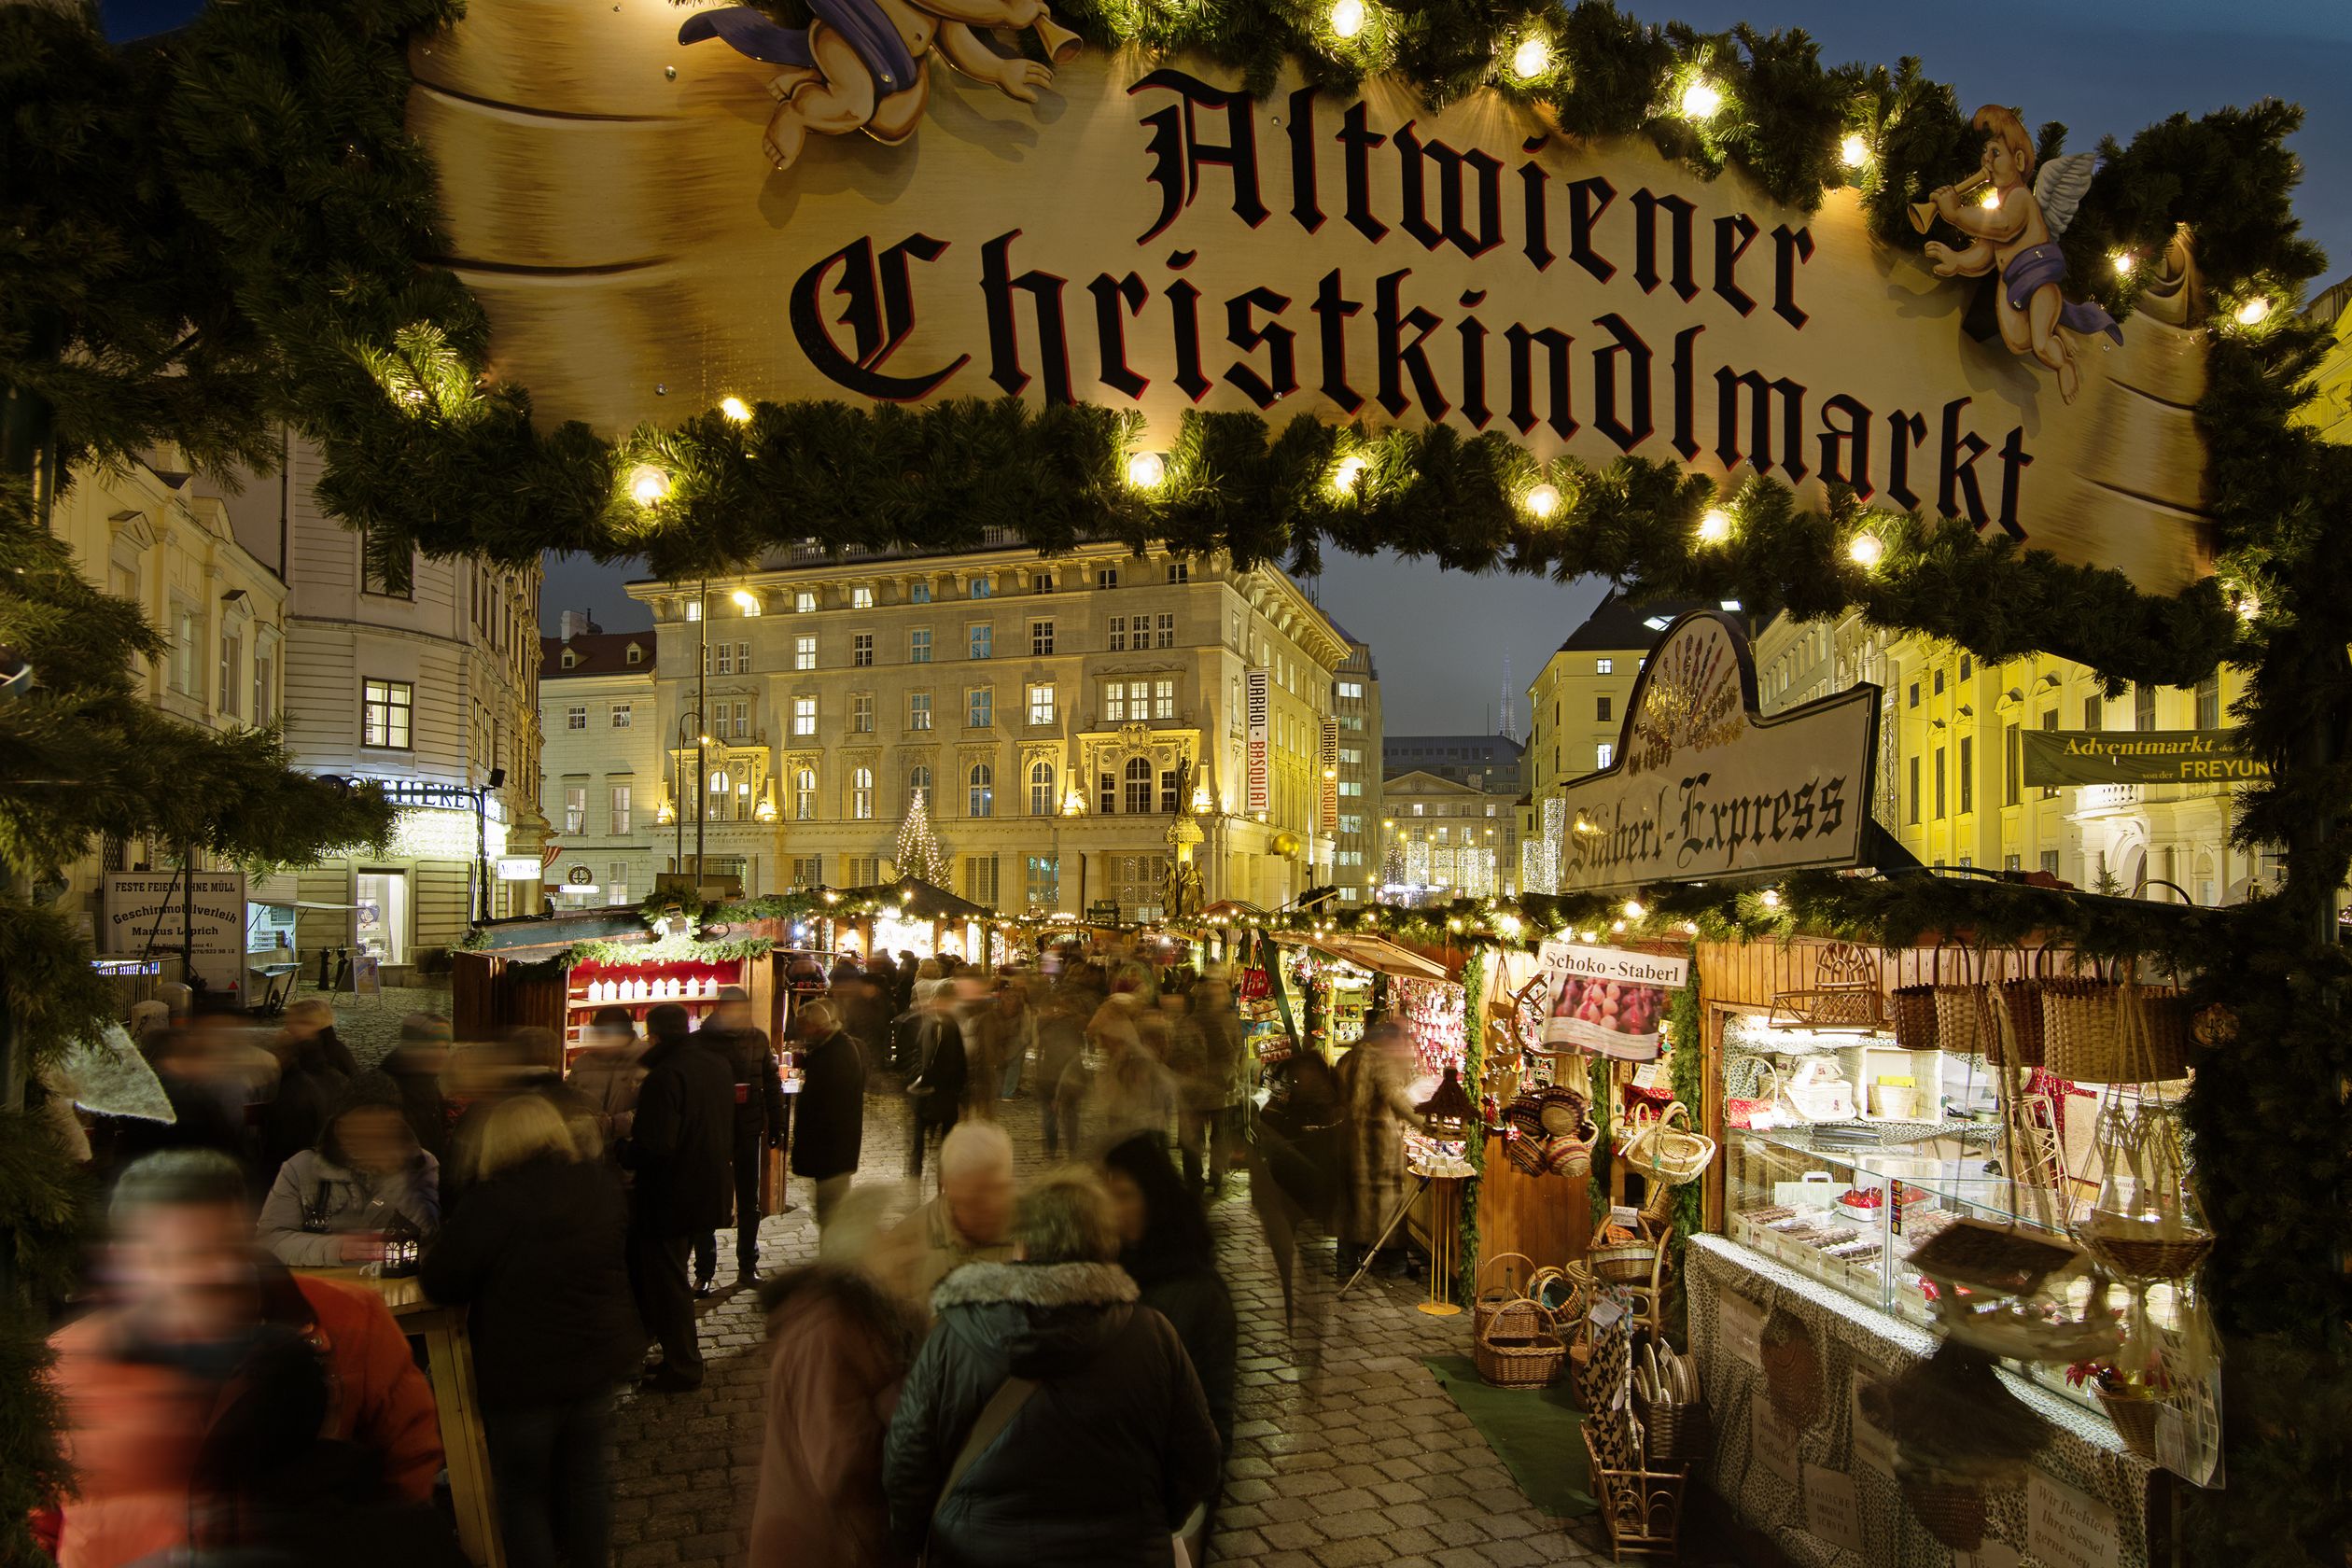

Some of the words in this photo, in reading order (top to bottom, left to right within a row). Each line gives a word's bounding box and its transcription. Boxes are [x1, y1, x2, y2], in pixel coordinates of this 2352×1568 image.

[1127, 67, 1814, 332] Altwiener
[788, 228, 2037, 544] Christkindlmarkt
[1249, 674, 1266, 731] WARHOL
[2063, 735, 2215, 755] Adventmarkt
[2142, 772, 2158, 780] von
[2159, 770, 2174, 779] der
[2180, 760, 2277, 778] FREYUN
[1248, 741, 1267, 808] BASQUIAT
[1565, 772, 1848, 884] Staberl-Express
[115, 881, 145, 892] FESTE
[184, 881, 208, 892] HNE
[210, 880, 236, 894] MÜLL
[176, 926, 218, 937] Lprich
[2205, 1017, 2225, 1035] 43
[2038, 1485, 2060, 1507] Wir
[2058, 1499, 2109, 1536] flechten
[2041, 1508, 2066, 1533] Ihre
[2067, 1524, 2106, 1558] Sessel
[2033, 1530, 2066, 1556] gerne
